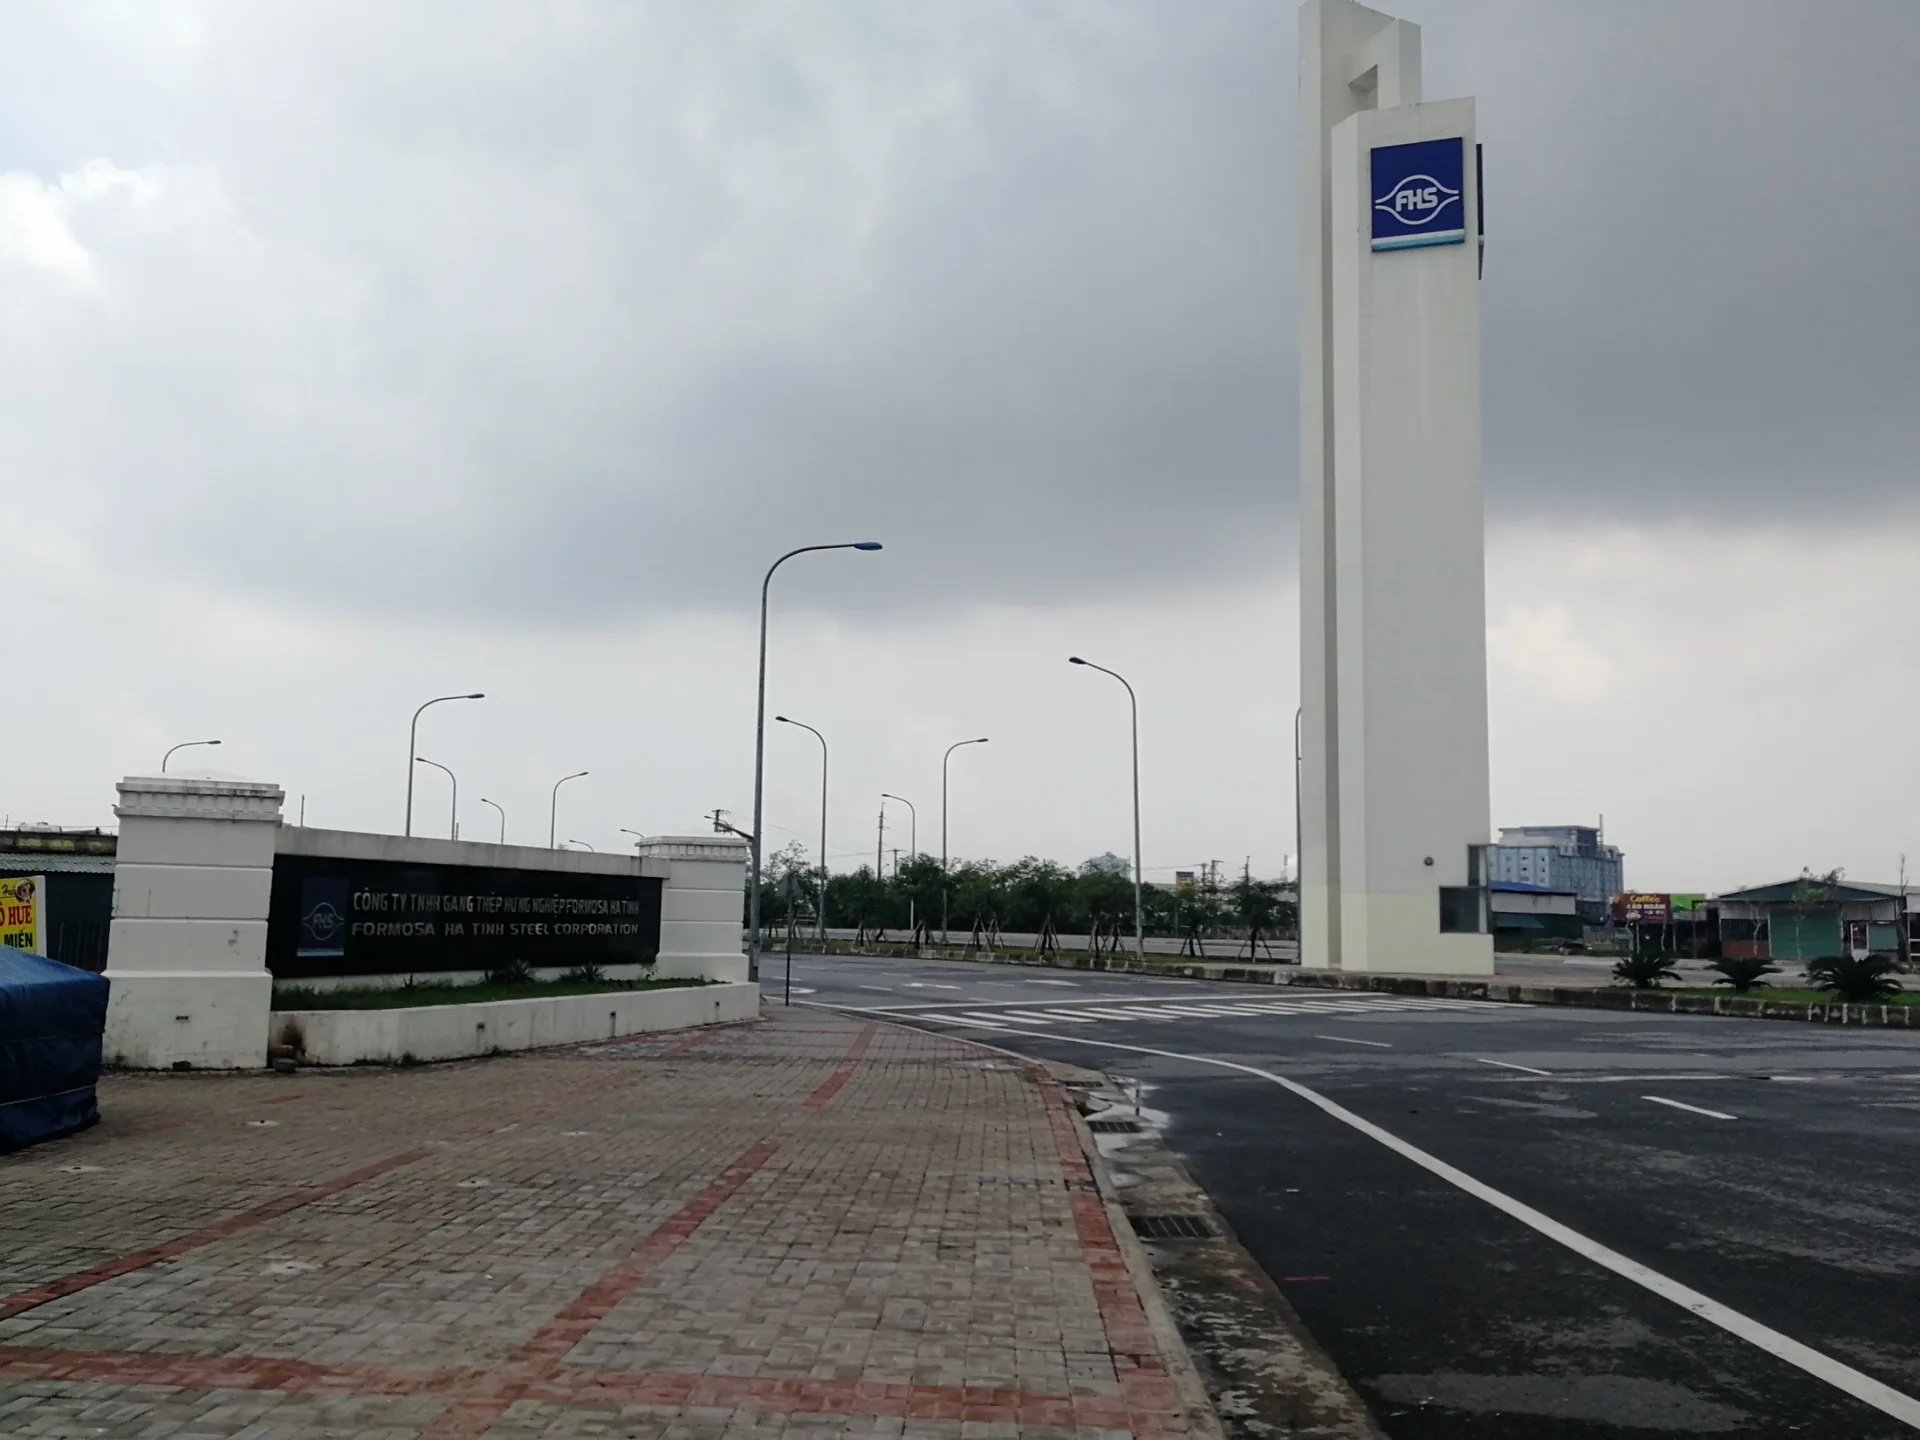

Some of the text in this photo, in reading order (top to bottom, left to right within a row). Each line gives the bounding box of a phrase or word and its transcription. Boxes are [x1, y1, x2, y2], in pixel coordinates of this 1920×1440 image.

[1395, 187, 1439, 212] FHS
[353, 887, 388, 912] CÔNG
[392, 893, 407, 912] TY
[411, 893, 440, 912] TNHH
[443, 894, 474, 913] GANG
[532, 893, 566, 918] NGHIỆP
[566, 898, 609, 915] FORMOSA
[313, 912, 334, 930] FHS
[351, 922, 639, 937] FORMOSA HA TINH STEEL CORPORATION
